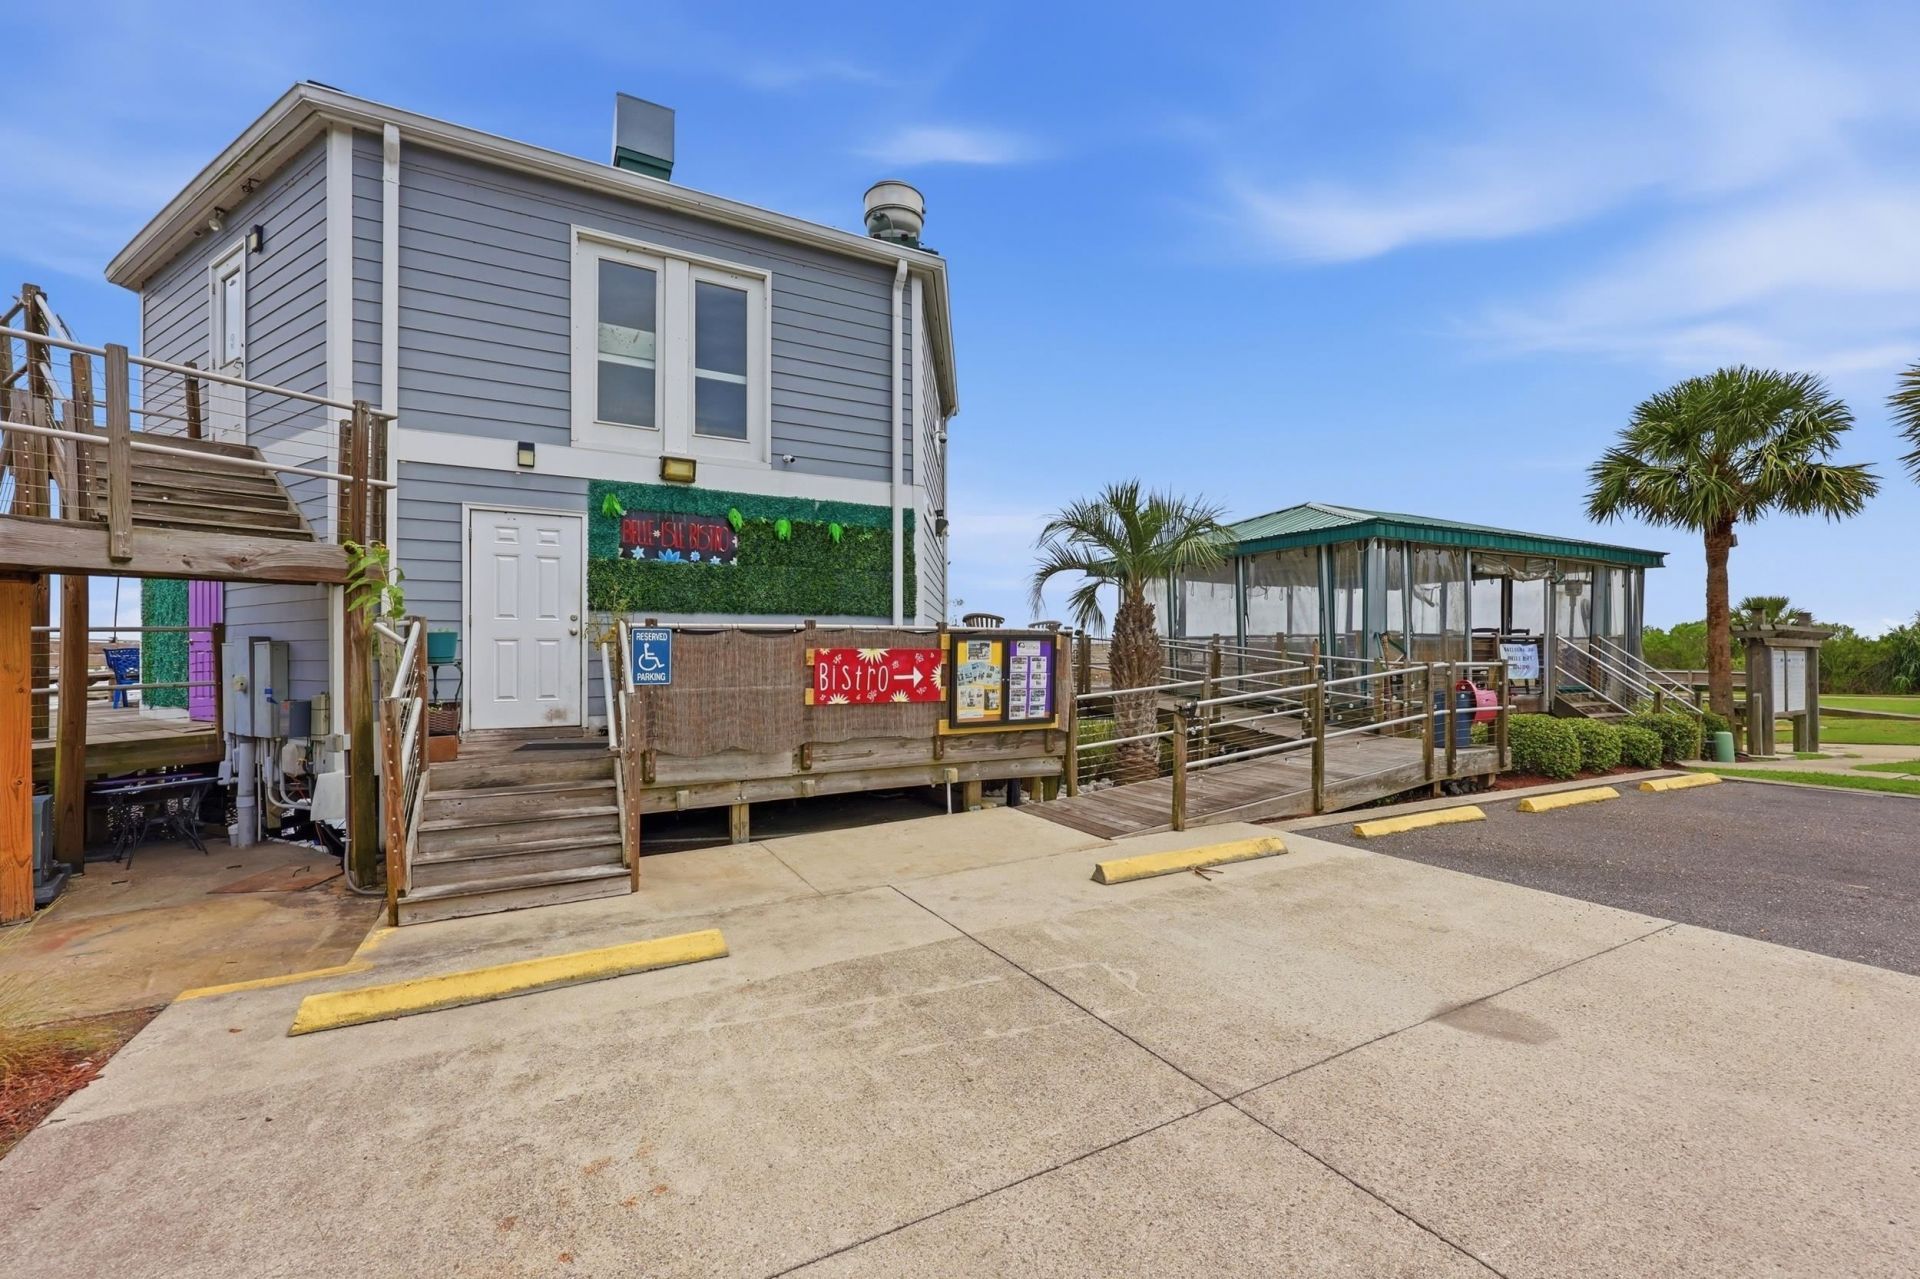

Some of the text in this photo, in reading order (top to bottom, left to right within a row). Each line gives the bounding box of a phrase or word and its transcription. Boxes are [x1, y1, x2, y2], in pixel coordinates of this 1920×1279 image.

[622, 519, 729, 552] BELLE ISLE BISTRO
[636, 632, 668, 641] RESERVED
[637, 672, 666, 681] PARKING
